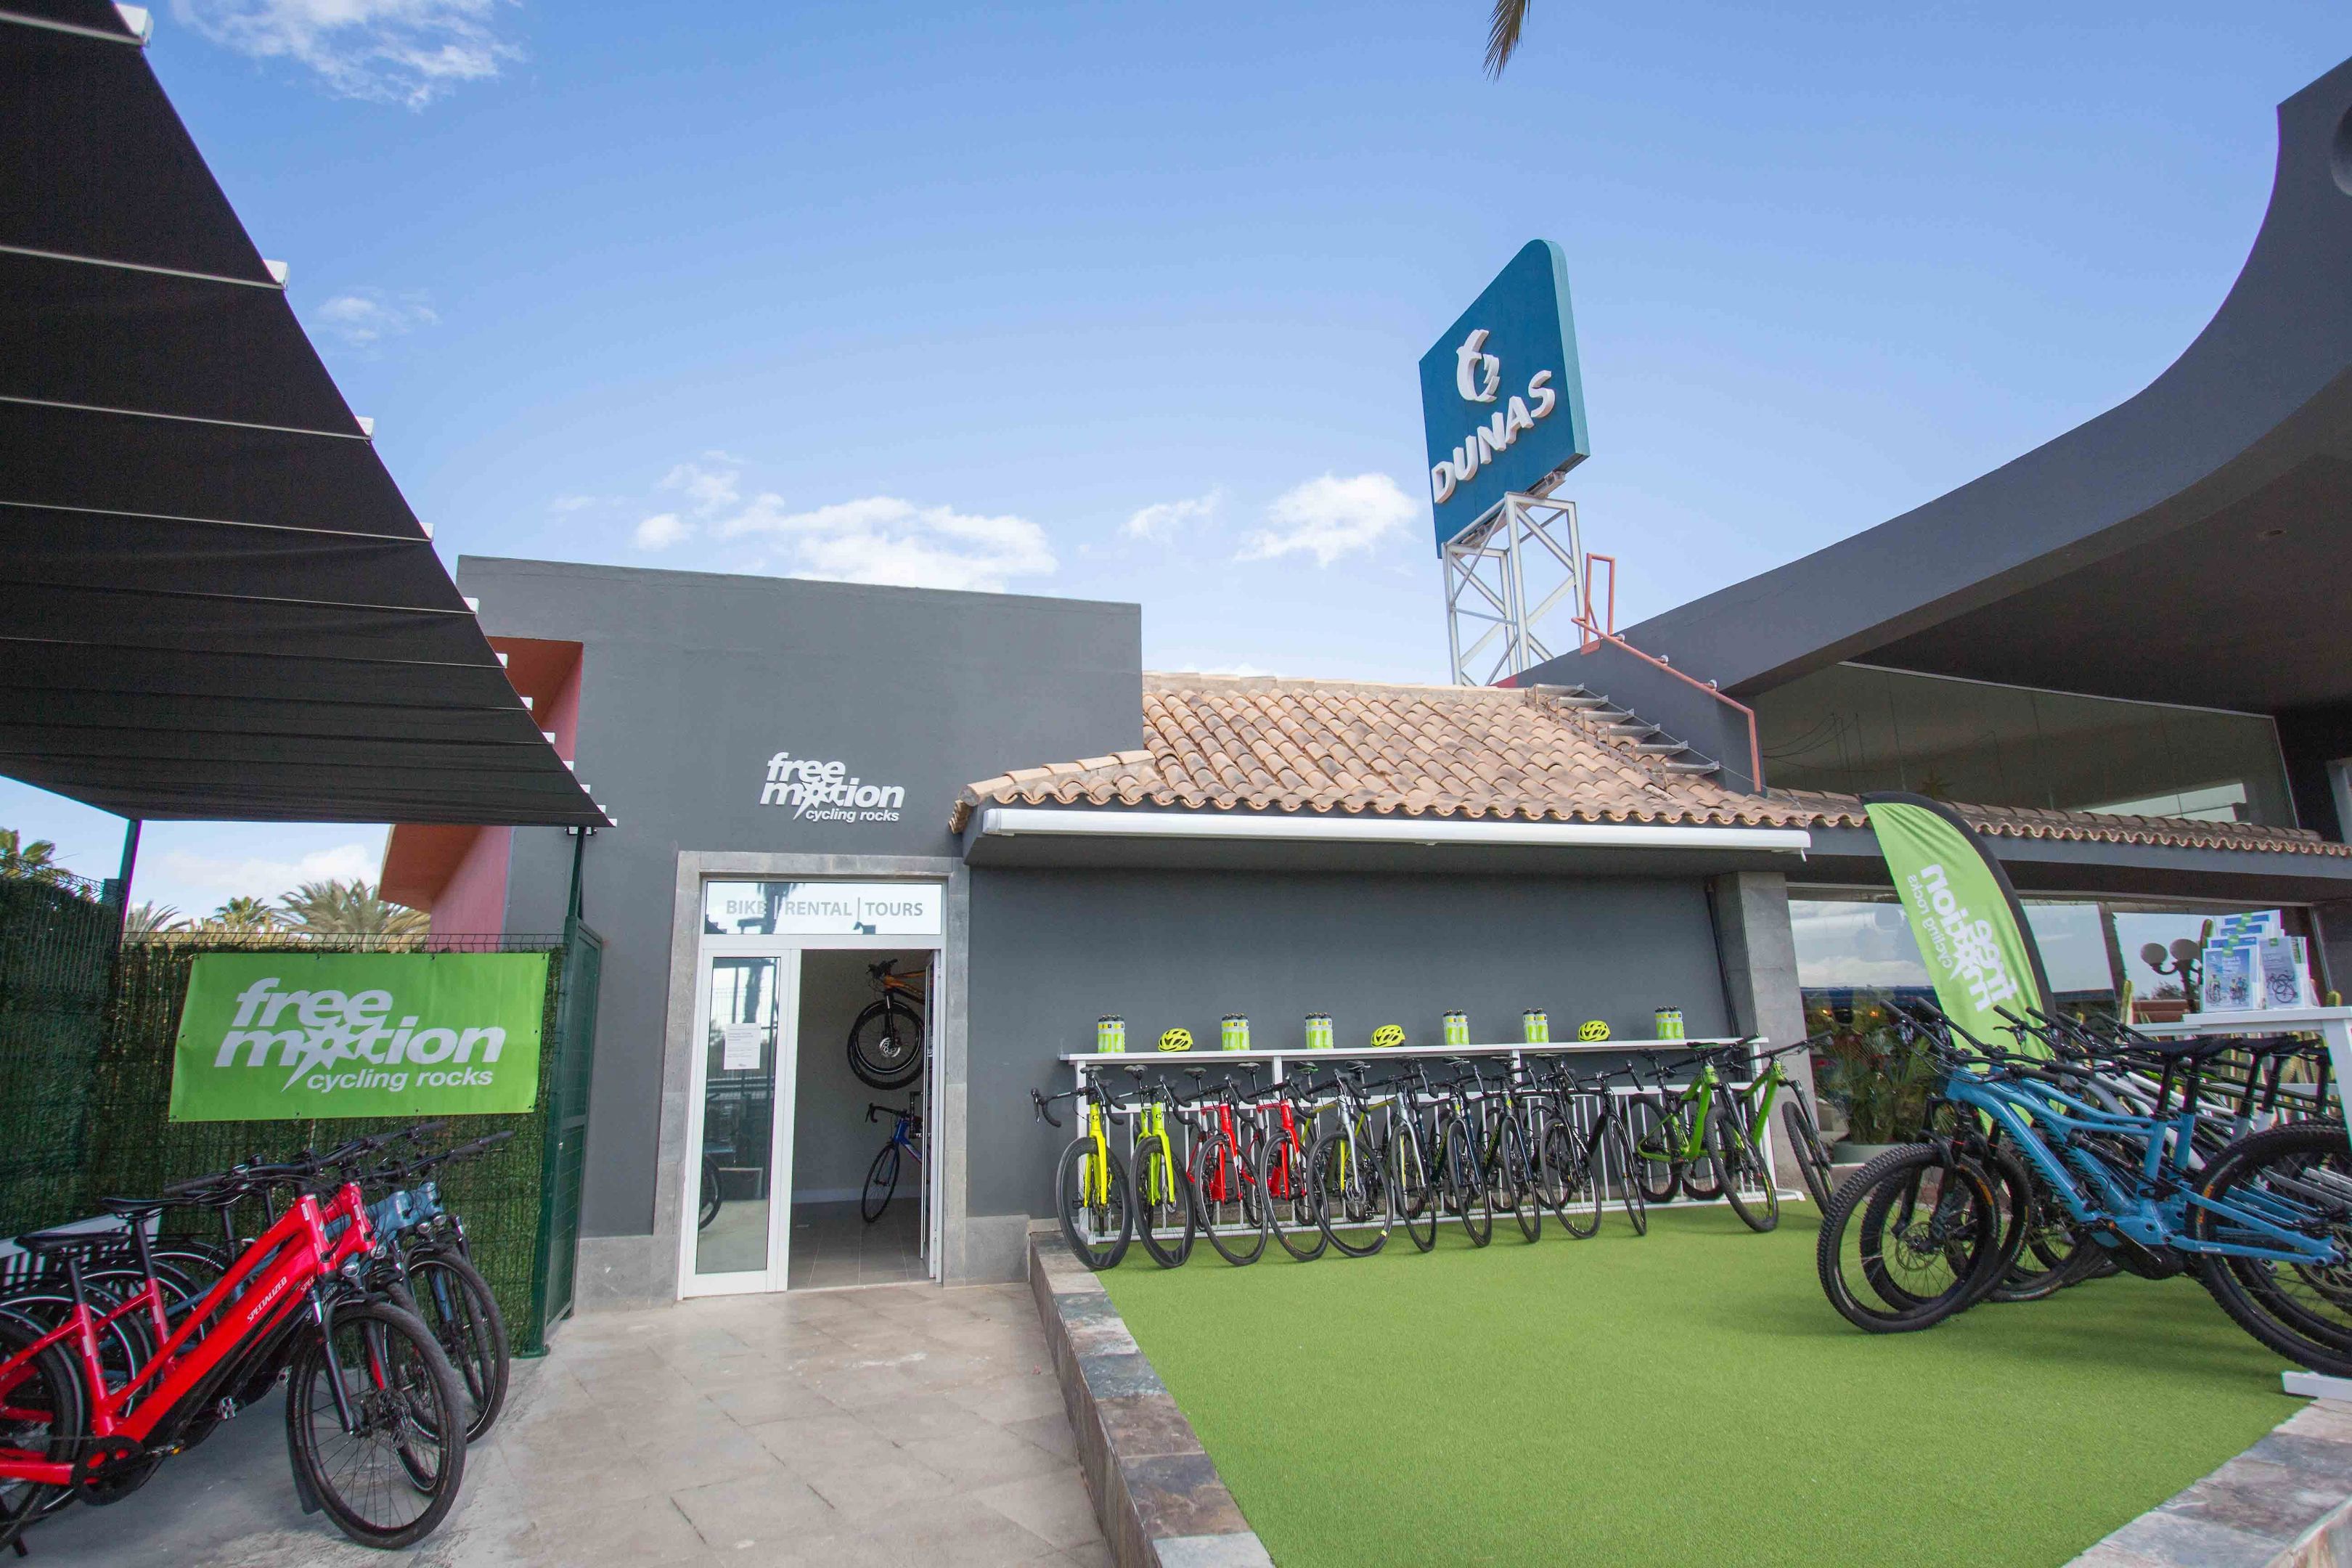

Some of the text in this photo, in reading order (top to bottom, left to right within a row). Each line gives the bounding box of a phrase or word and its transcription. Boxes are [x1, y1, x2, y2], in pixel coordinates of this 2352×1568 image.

[1432, 369, 1556, 504] DUNAS
[767, 751, 846, 783] free
[805, 808, 900, 823] cycling rocks
[726, 899, 923, 917] BIKE RENTAL TOURS
[232, 977, 393, 1027] free
[306, 1066, 493, 1093] cycling rocks
[247, 1275, 287, 1323] SPECIALIZED
